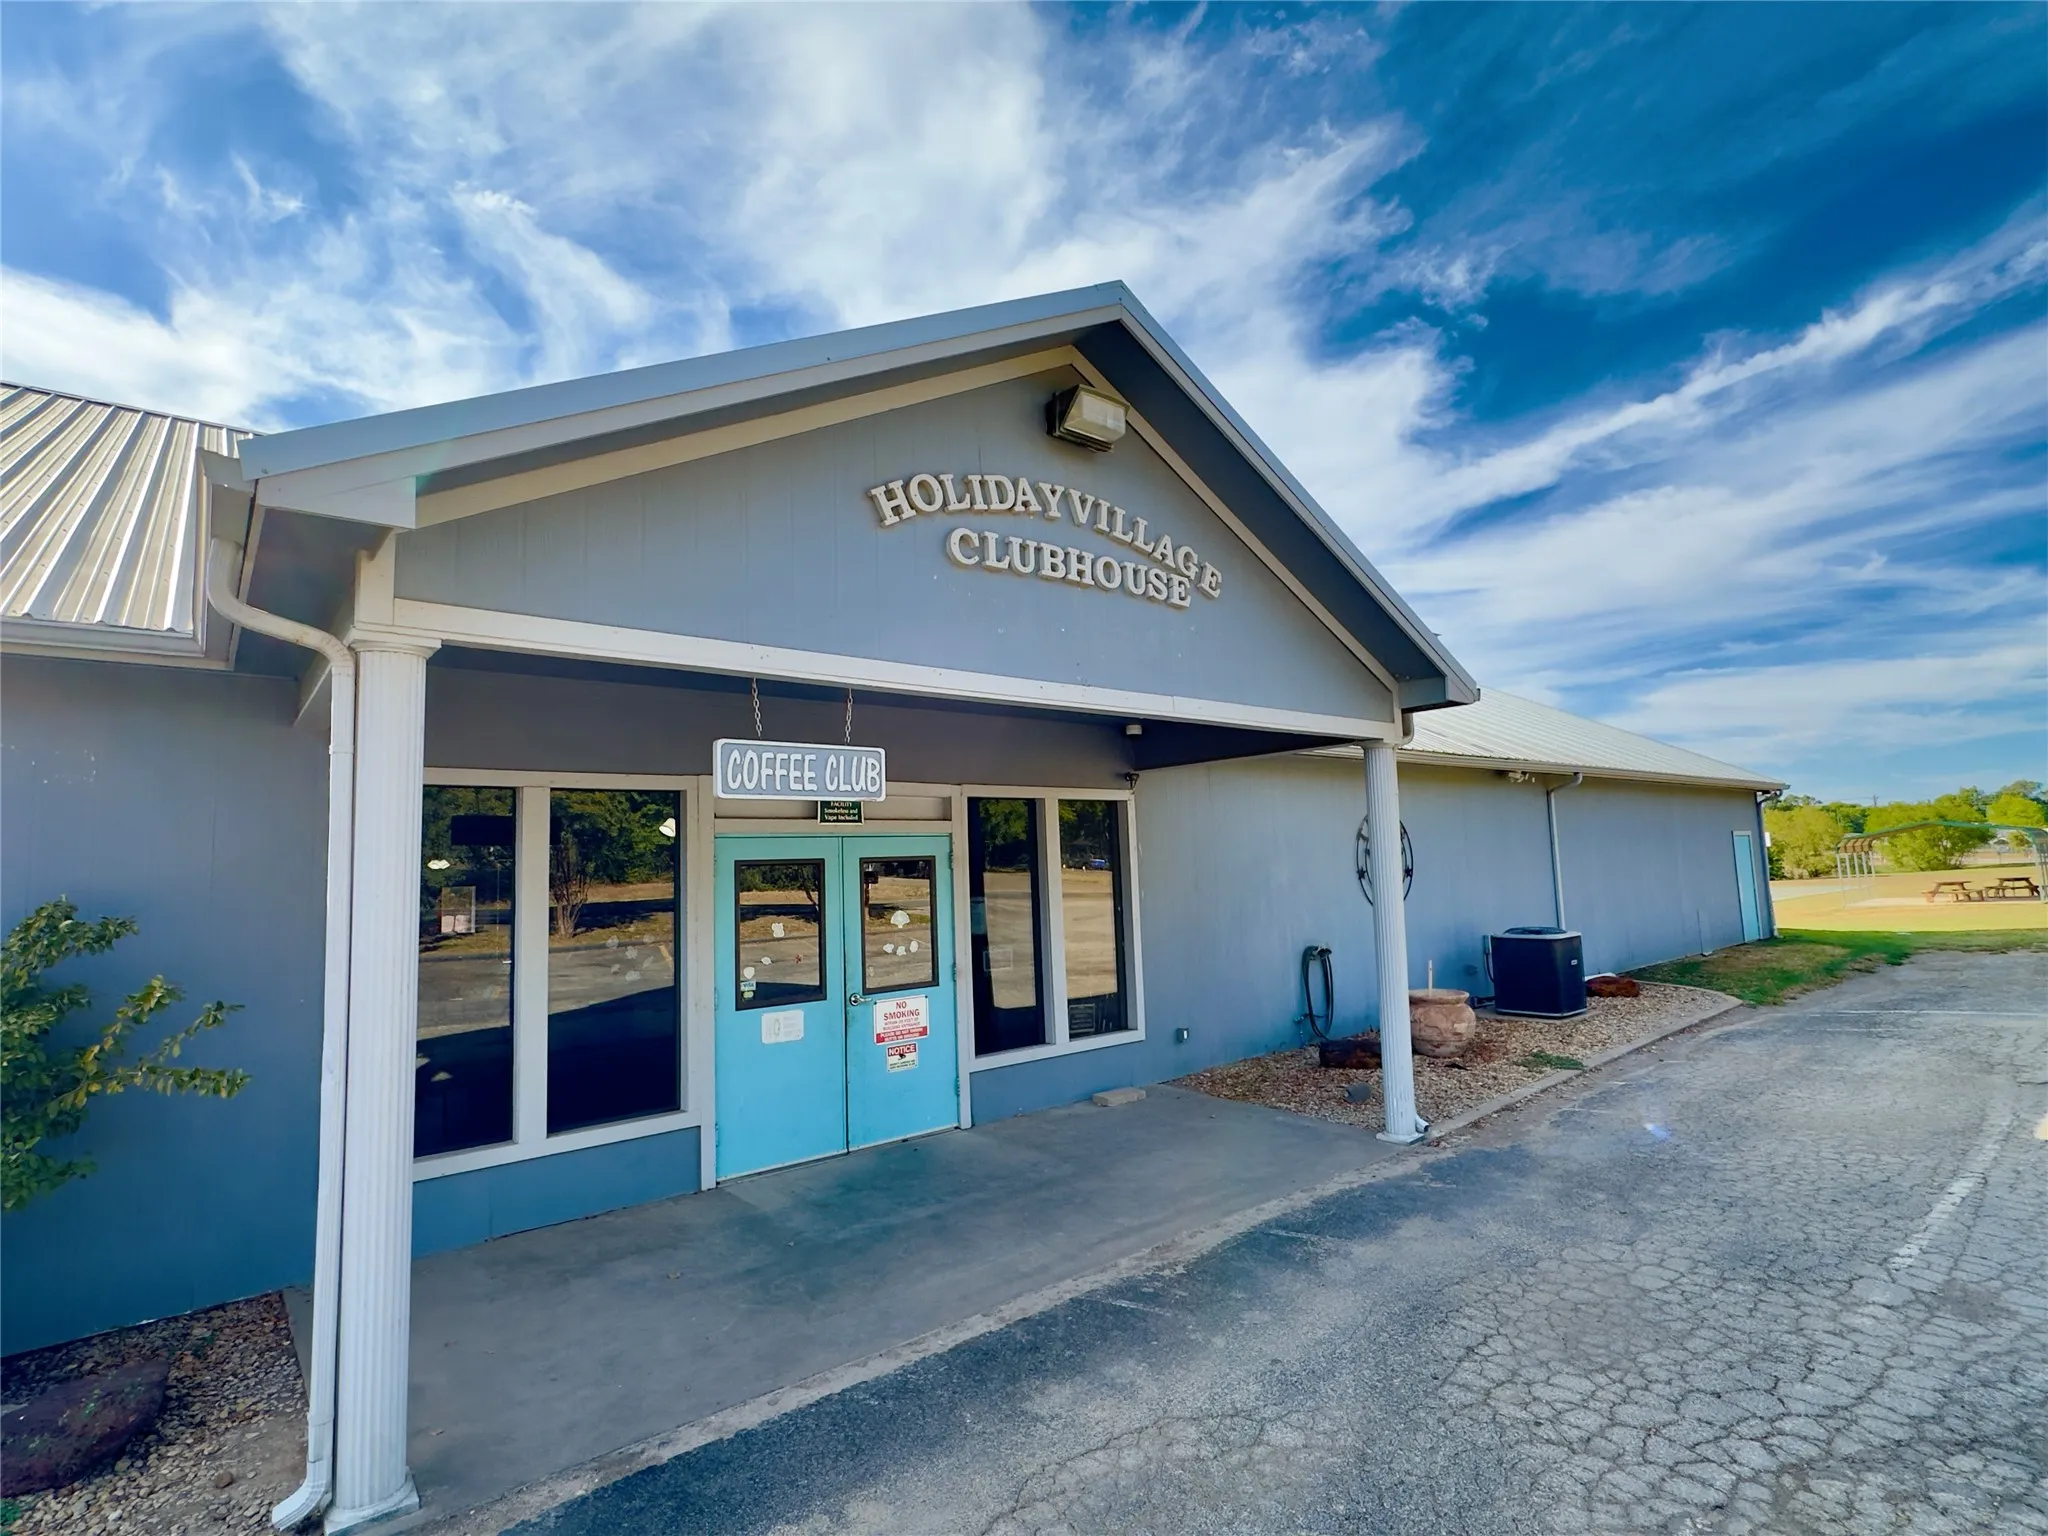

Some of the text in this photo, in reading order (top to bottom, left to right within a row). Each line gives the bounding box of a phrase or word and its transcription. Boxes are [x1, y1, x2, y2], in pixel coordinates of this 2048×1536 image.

[868, 473, 1222, 599] HOLIDAY VILLAGE
[946, 527, 1192, 609] CLUBHOUSE
[727, 749, 881, 793] COFFEE CLUB
[884, 1008, 920, 1021] SMOKING
[896, 1001, 907, 1009] NO
[888, 1044, 915, 1056] NOTICE
